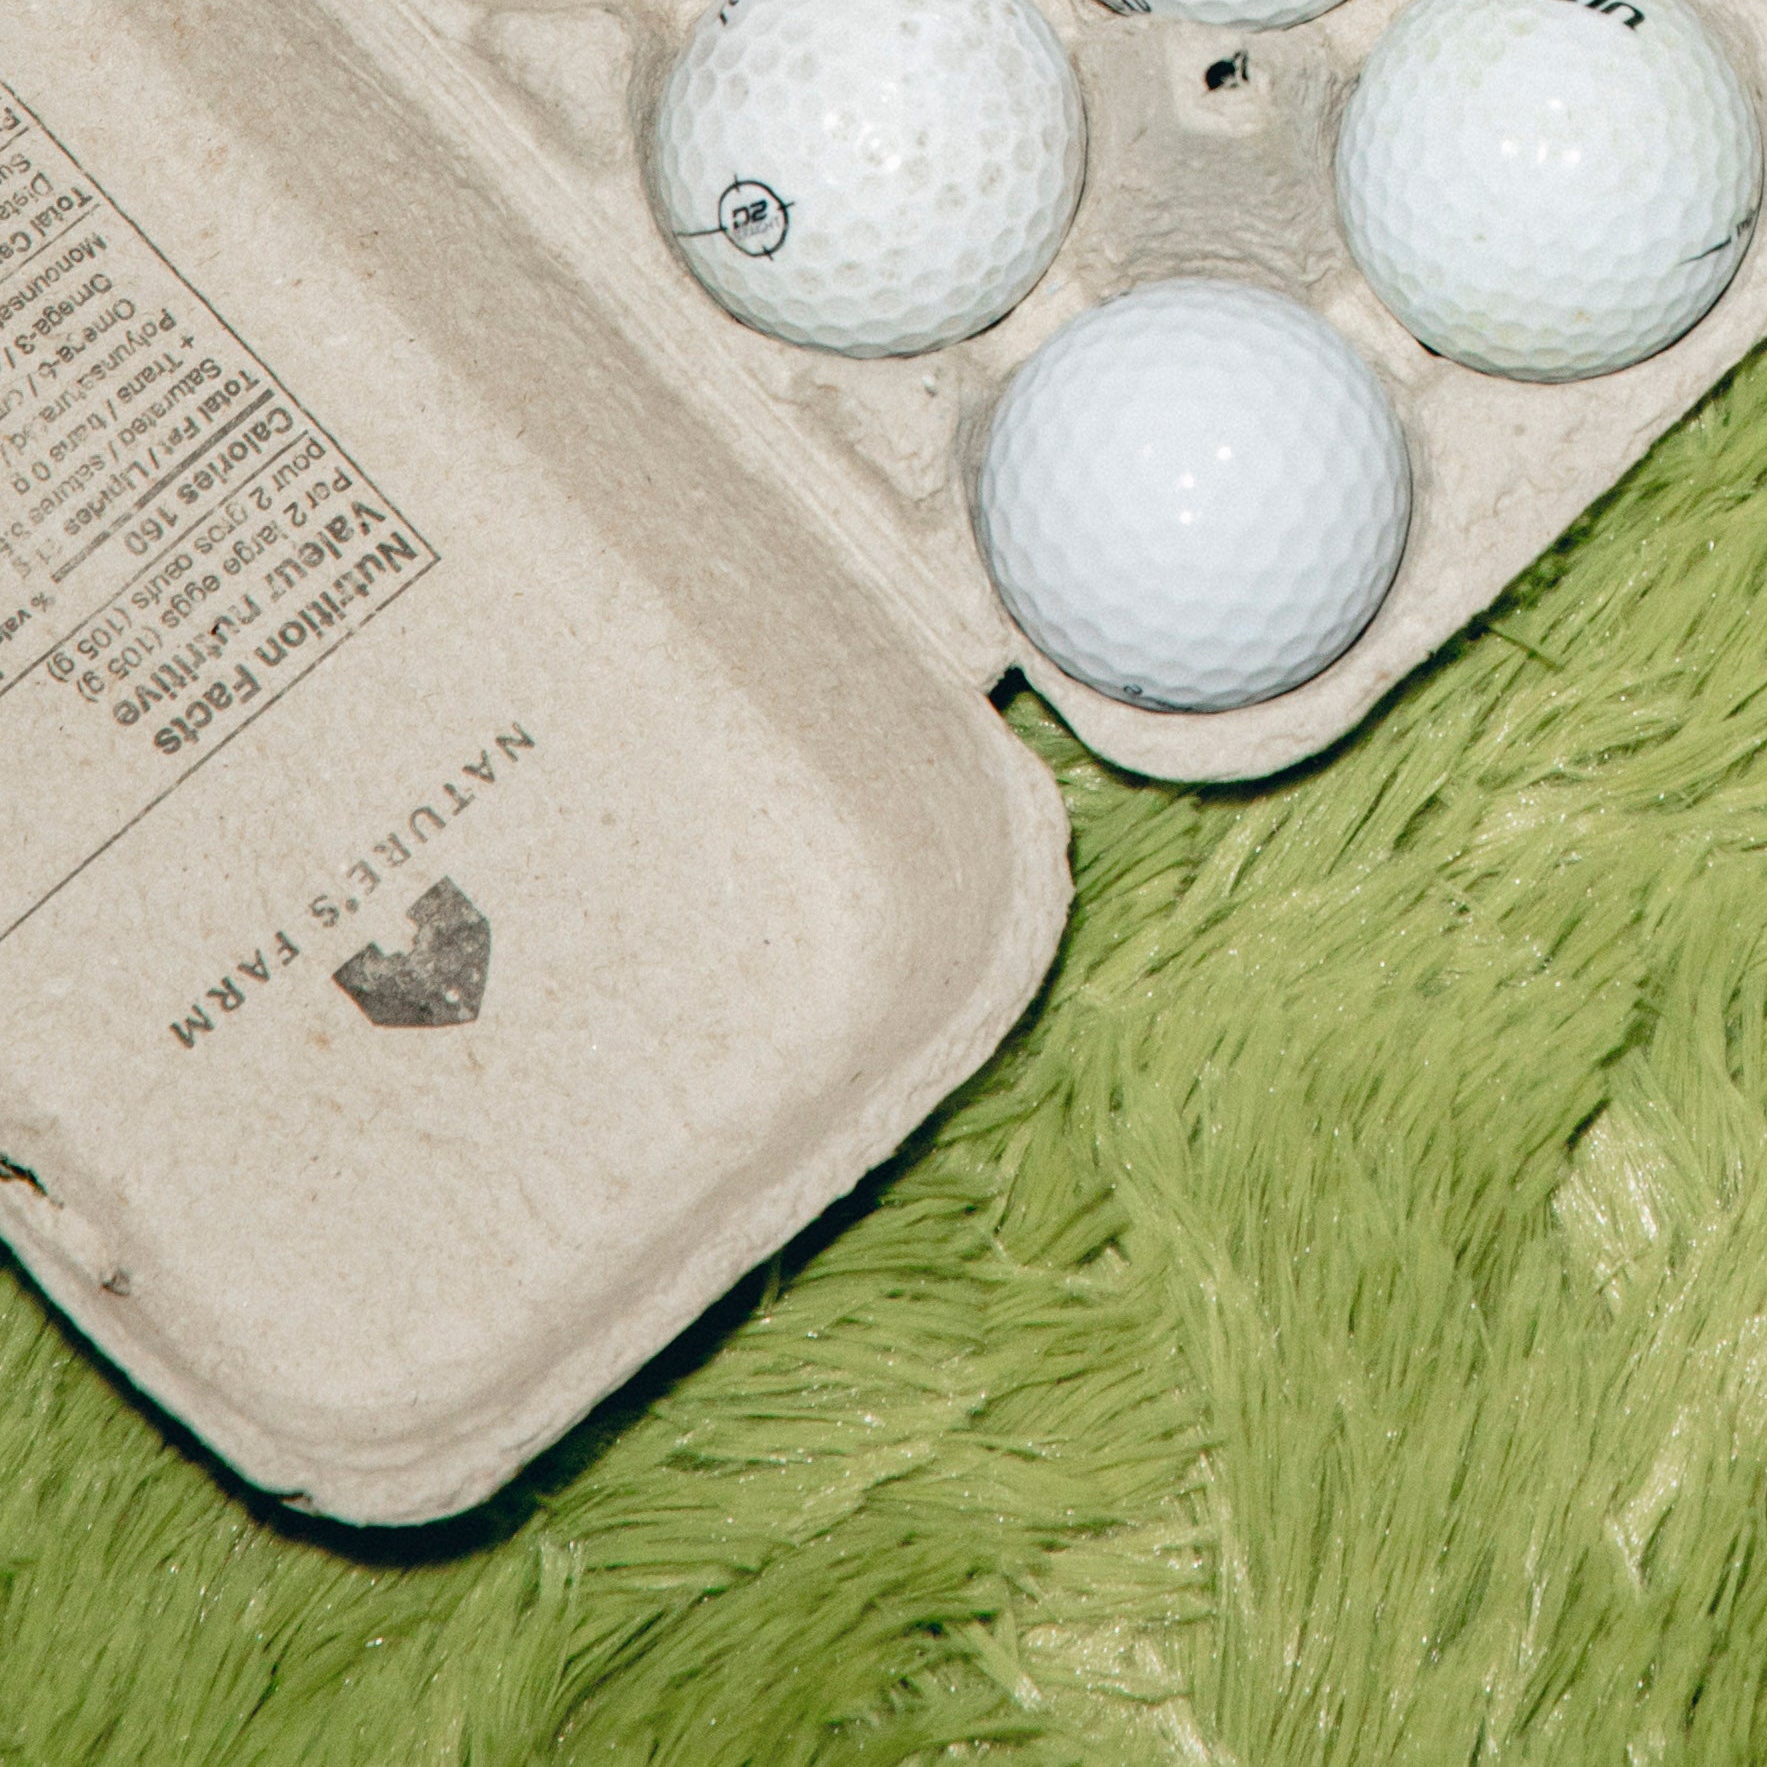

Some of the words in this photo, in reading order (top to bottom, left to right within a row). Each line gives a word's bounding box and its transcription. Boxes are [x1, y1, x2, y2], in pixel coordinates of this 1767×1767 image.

[28, 185, 94, 239] Total
[114, 351, 185, 405] Trans
[115, 356, 223, 448] Saturated
[195, 368, 261, 424] Total
[175, 405, 294, 506] Calories
[270, 435, 327, 493] pour
[247, 484, 273, 512] 2
[281, 500, 308, 529] 2
[123, 504, 179, 556] 160
[221, 518, 290, 576] large
[262, 499, 387, 604] Valeur
[159, 572, 221, 629] eggs
[252, 529, 419, 668] Nutrition
[110, 592, 263, 727] nutritive
[151, 662, 263, 756] Facts
[169, 930, 300, 1049] FARM
